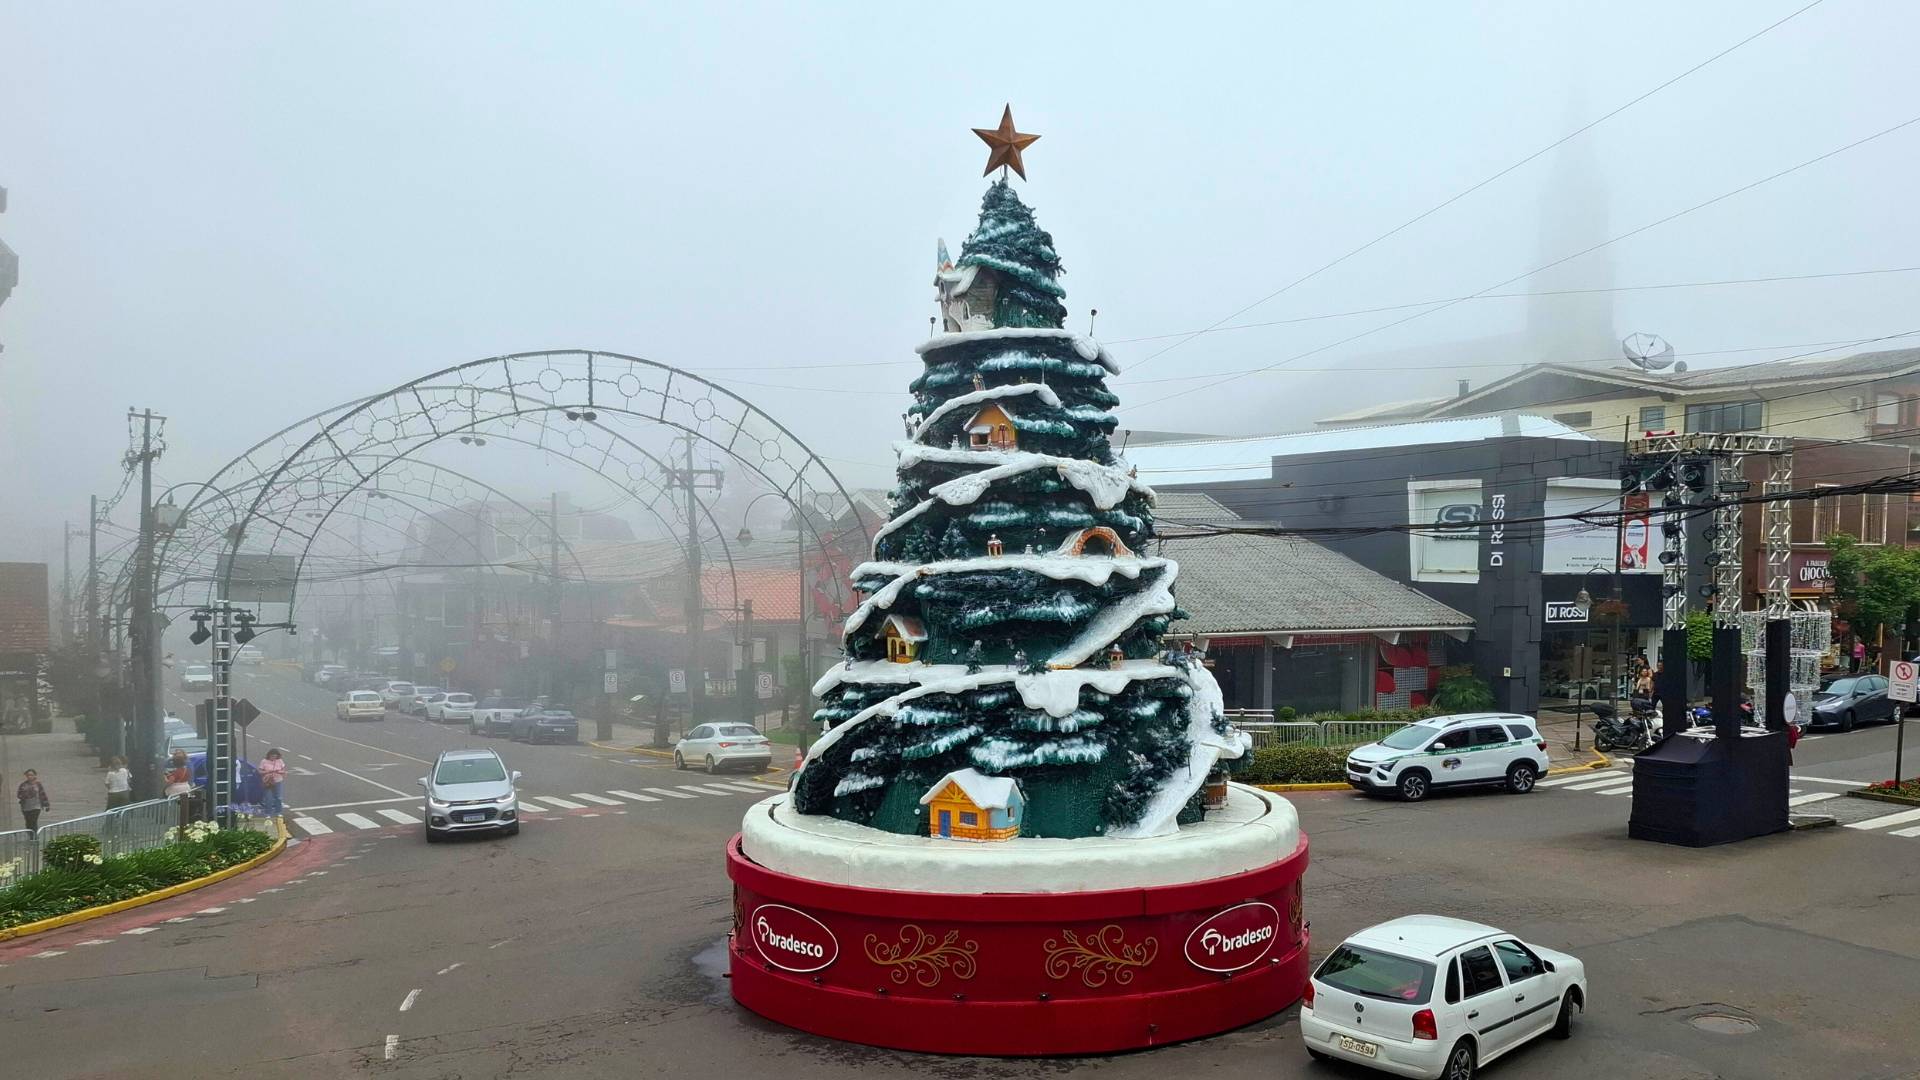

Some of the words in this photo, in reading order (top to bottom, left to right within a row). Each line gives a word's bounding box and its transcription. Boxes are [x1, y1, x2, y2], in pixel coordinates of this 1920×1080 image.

[1491, 494, 1505, 544] ROSSI
[1490, 552, 1503, 566] DI
[1549, 607, 1557, 618] DI
[1560, 607, 1585, 617] ROSSI
[769, 927, 823, 958] bradesco
[1222, 925, 1272, 952] bradesco
